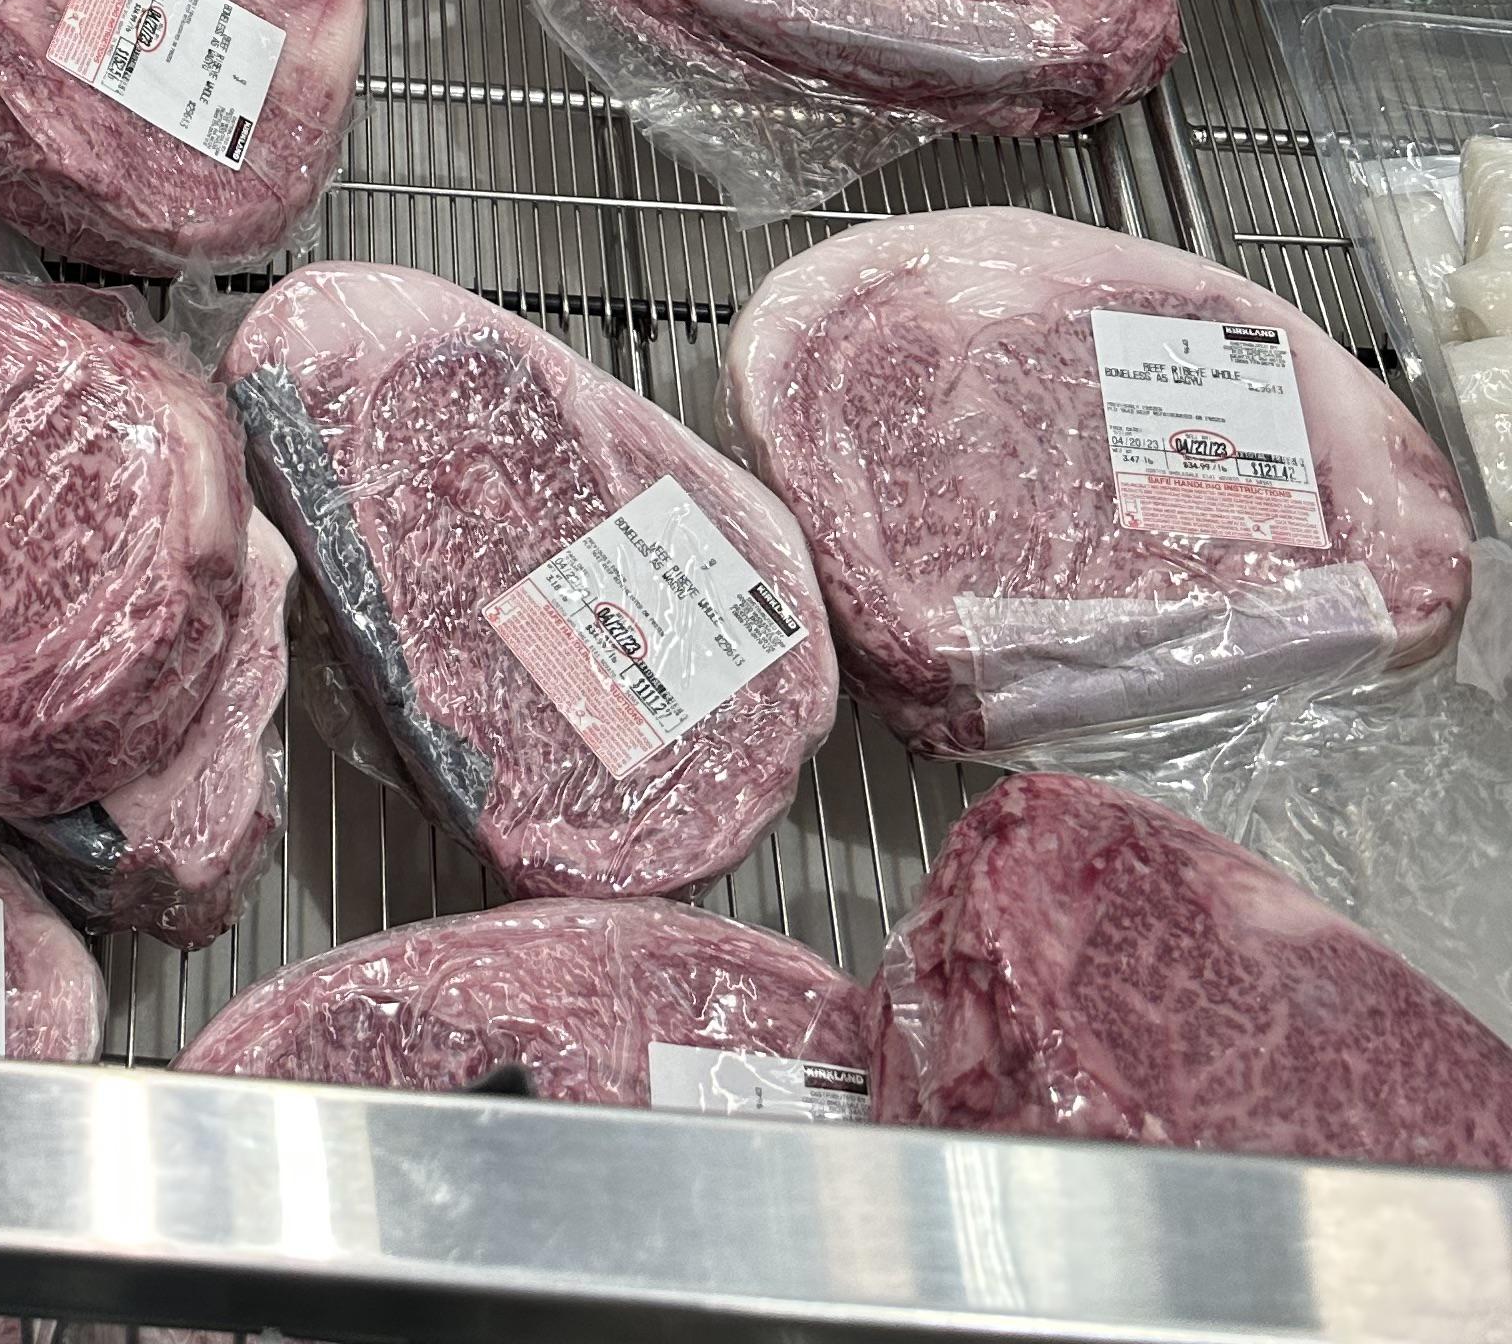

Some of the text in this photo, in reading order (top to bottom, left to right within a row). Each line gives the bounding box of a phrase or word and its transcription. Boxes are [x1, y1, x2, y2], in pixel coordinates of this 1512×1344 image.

[136, 7, 162, 47] 04/27/23
[213, 2, 233, 37] BONELESS
[216, 32, 231, 53] BEEF
[198, 79, 214, 105] WHOLE
[1224, 326, 1276, 338] KIRKLAND
[1104, 367, 1151, 381] BONELESS
[1170, 364, 1207, 378] RIBEYE
[1210, 368, 1241, 381] WHOLE
[1111, 435, 1159, 449] 04/20/23
[1174, 437, 1228, 457] 04/27/23
[1147, 475, 1171, 485] SAFE
[1223, 484, 1291, 498] INSTRUCTIONS
[614, 515, 688, 600] BONELESS WAGYU
[542, 602, 563, 626] SAFE
[595, 605, 642, 657] 04/27/23
